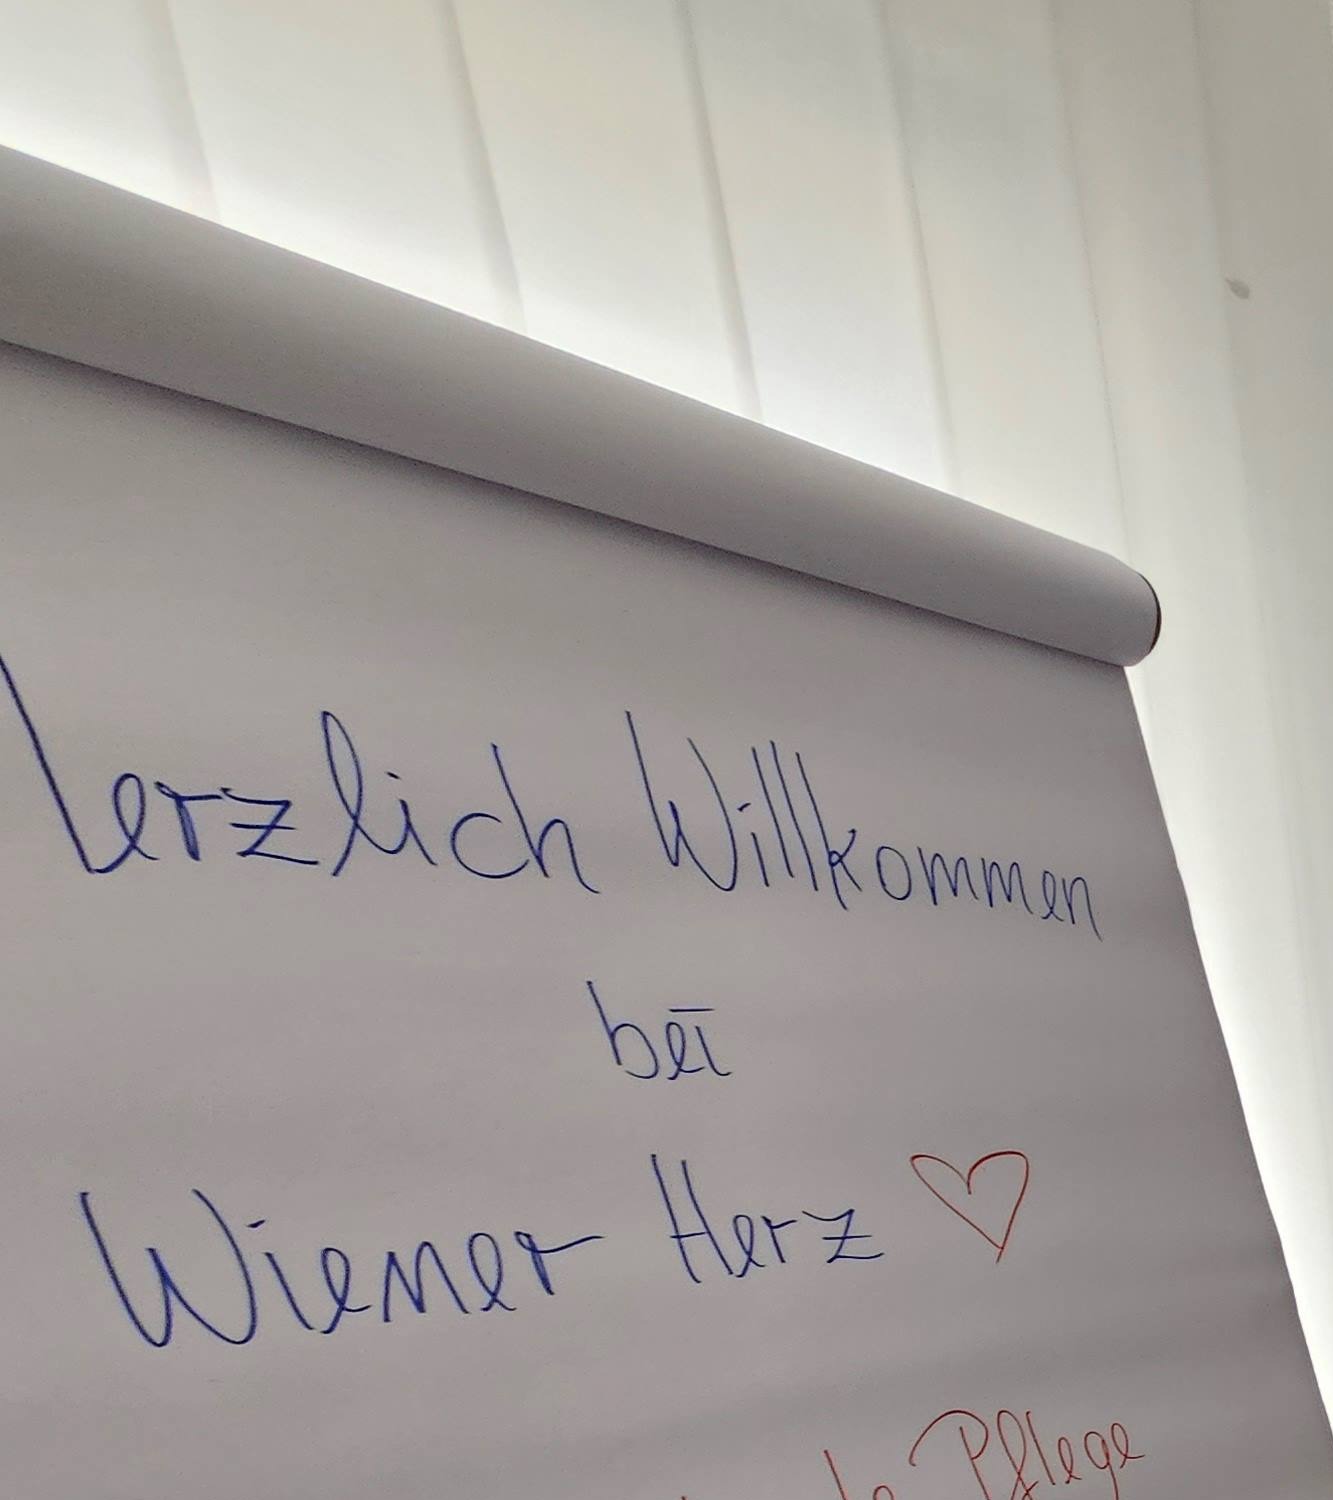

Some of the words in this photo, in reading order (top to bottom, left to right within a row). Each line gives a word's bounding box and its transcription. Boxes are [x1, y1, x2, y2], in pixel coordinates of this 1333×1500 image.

[625, 709, 1103, 941] Willkommen
[586, 980, 732, 1080] bei
[79, 1189, 605, 1349] Wiener
[650, 1153, 884, 1284] Herz
